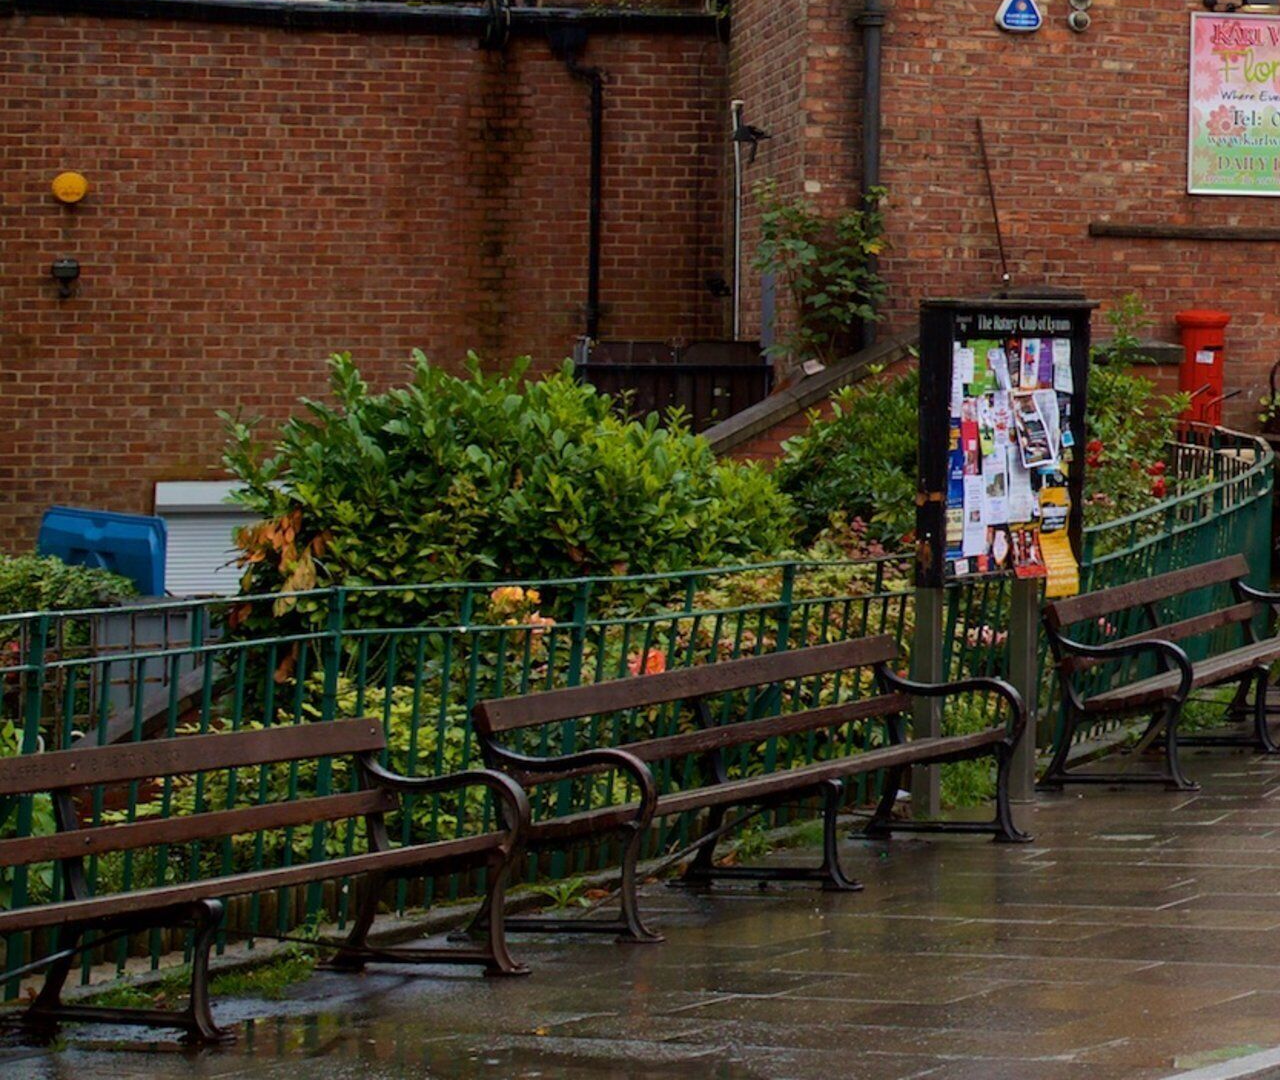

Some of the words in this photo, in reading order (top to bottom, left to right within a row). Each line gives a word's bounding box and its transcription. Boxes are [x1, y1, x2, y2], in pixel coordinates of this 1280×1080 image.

[1213, 24, 1264, 47] KARL
[1220, 90, 1255, 102] Where
[1231, 110, 1263, 127] Tel:
[1217, 156, 1267, 171] DAILY
[977, 314, 992, 330] The
[993, 314, 1018, 333] Rotary
[1019, 314, 1037, 330] Club
[1038, 314, 1047, 330] of
